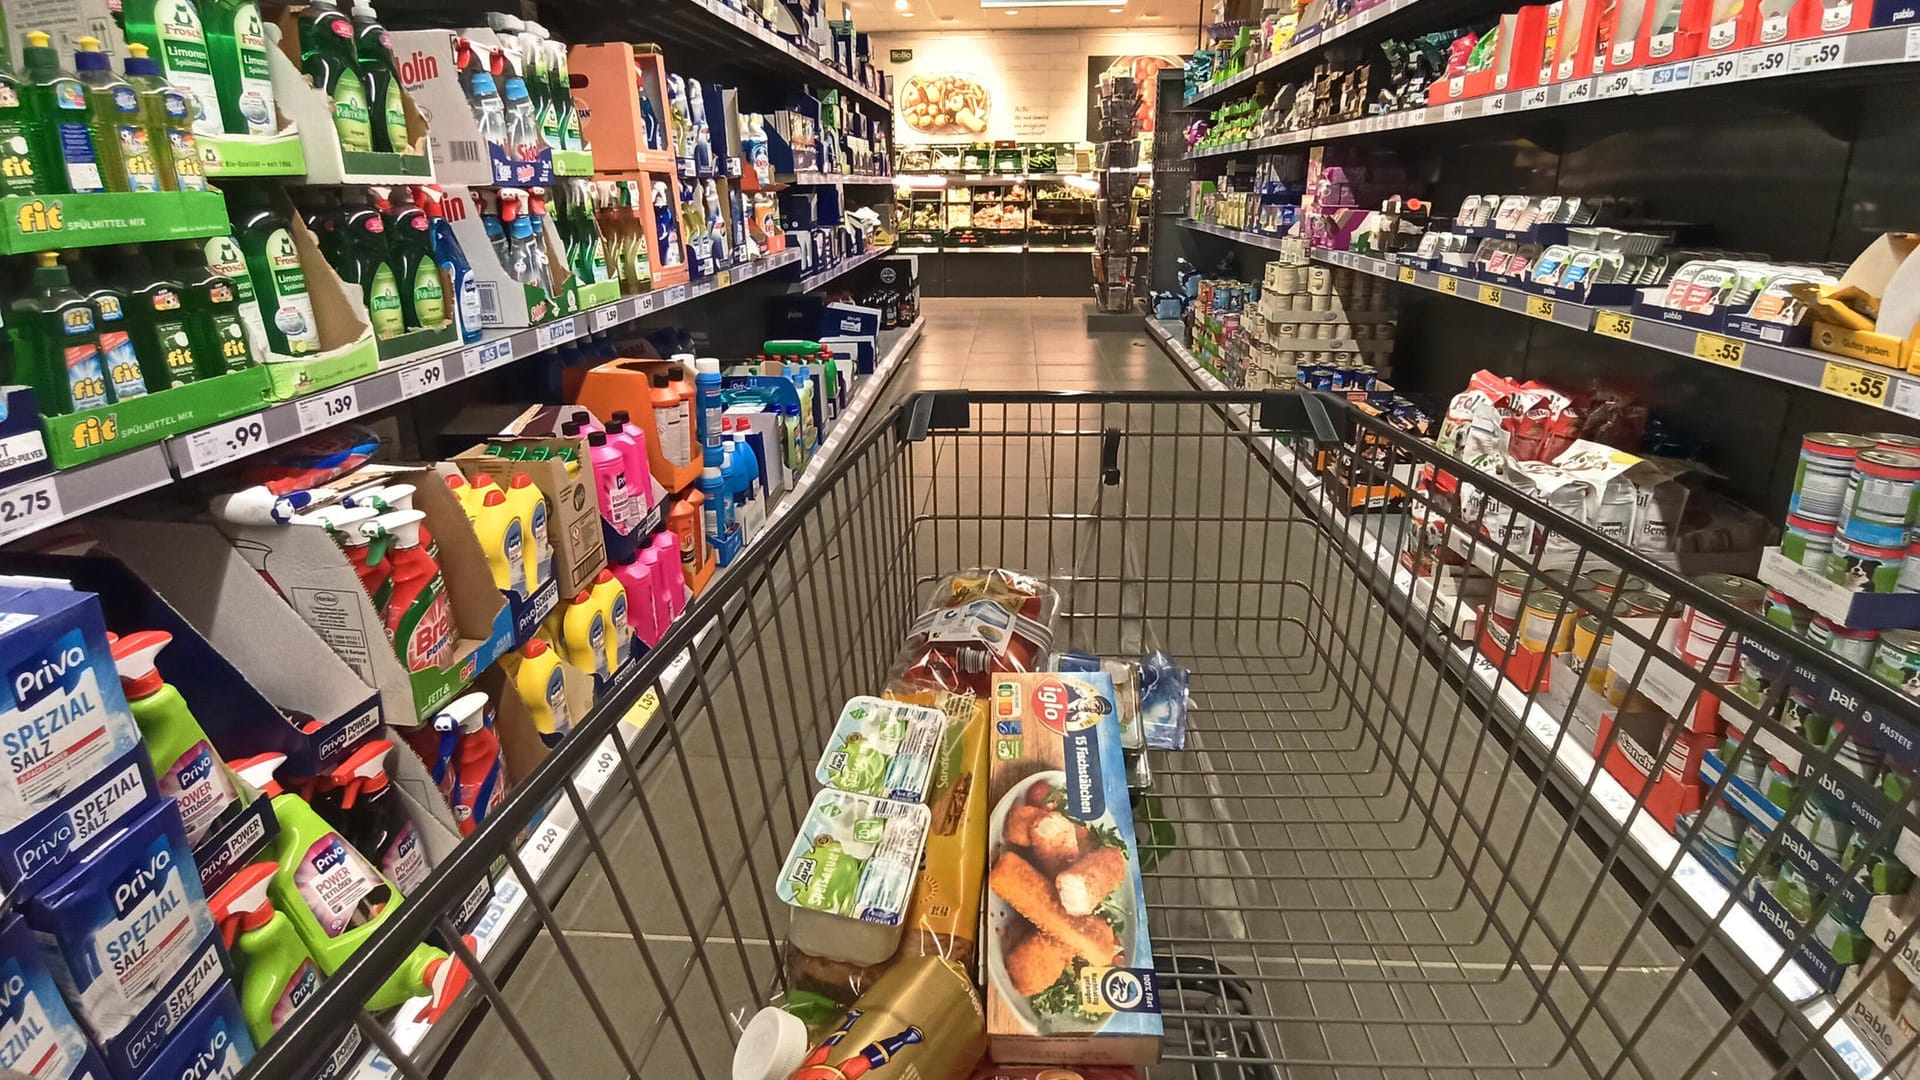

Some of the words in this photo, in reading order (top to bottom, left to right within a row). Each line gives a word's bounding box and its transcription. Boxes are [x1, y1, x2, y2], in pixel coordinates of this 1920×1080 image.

[1893, 8, 1915, 22] pablo
[2, 156, 34, 176] fit
[128, 155, 155, 175] fit
[177, 159, 202, 177] fit
[18, 200, 63, 233] fit
[67, 219, 127, 231] SPÜLMITTEL
[66, 311, 90, 327] fit
[1663, 311, 1683, 322] pablo
[168, 349, 193, 367] fit
[223, 340, 247, 358] fit
[1715, 344, 1739, 361] -.55
[112, 362, 142, 385] fit
[1850, 377, 1882, 398] -.55
[72, 379, 105, 400] fit
[324, 394, 353, 418] 1.39
[72, 415, 117, 449] fit
[121, 416, 178, 438] SPÜLMITTEL
[178, 410, 194, 424] MIX
[1, 490, 51, 522] 2.75
[15, 645, 86, 702] Priva
[1038, 686, 1063, 720] iglo
[3, 692, 96, 757] SPEZIAL
[348, 714, 371, 736] POWER
[1879, 723, 1914, 751] PASTETE
[321, 734, 346, 756] Priva
[1075, 735, 1088, 746] 15
[10, 740, 54, 774] SALZ
[181, 757, 211, 786] Priva
[177, 782, 213, 809] POWER
[1076, 747, 1093, 814] Fischstäbchen
[74, 772, 141, 828] SPEZIAL
[79, 810, 110, 840] SALZ
[1851, 800, 1884, 831] PASTETE
[22, 826, 73, 871] Priva
[231, 818, 261, 850] POWER
[536, 827, 558, 854] 2.29
[201, 850, 230, 881] Priva
[315, 846, 345, 871] Priva
[1781, 831, 1820, 872] pablo
[114, 850, 171, 914] Priva
[315, 867, 351, 896] POWER
[106, 889, 181, 963] SPEZIAL
[1757, 899, 1796, 941] pablo
[1800, 943, 1829, 975] PASTETE
[114, 940, 151, 977] SALZ
[169, 953, 218, 1013] SPEZIAL
[292, 971, 316, 1004] Priva
[174, 993, 198, 1023] SALZ
[131, 1014, 168, 1061] Priva
[1855, 1000, 1893, 1047] pablo
